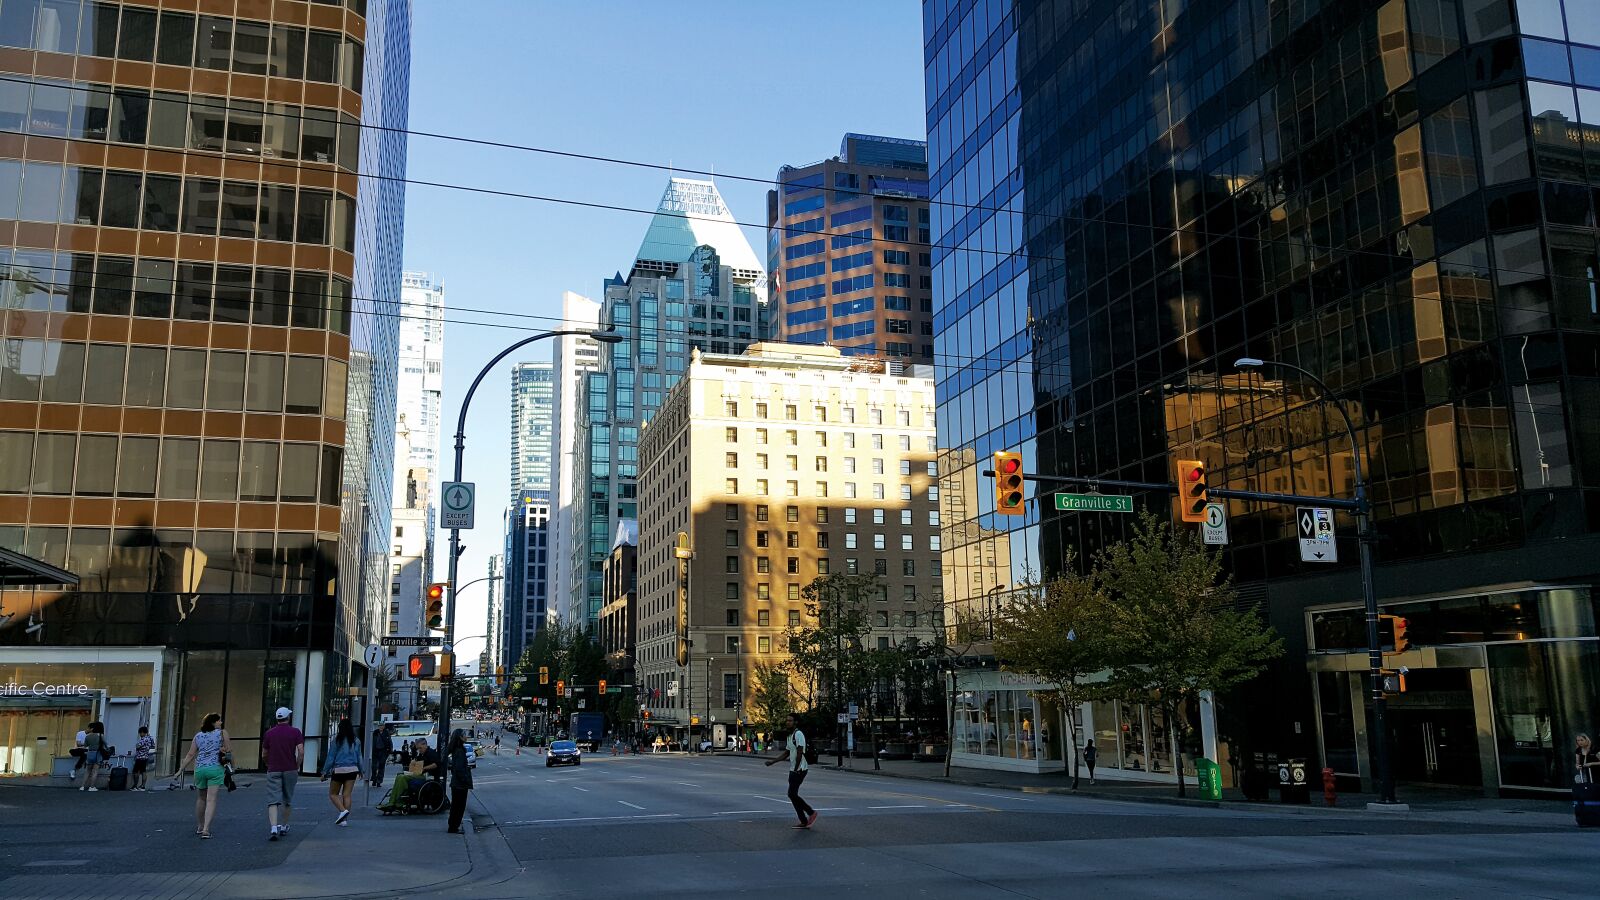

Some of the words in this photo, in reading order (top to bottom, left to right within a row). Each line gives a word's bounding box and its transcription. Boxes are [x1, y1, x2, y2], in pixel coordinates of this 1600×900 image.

[1062, 496, 1112, 509] Granville
[1115, 498, 1126, 510] St
[447, 519, 468, 527] BUSES
[383, 637, 418, 646] Granville
[33, 681, 88, 695] Centre
